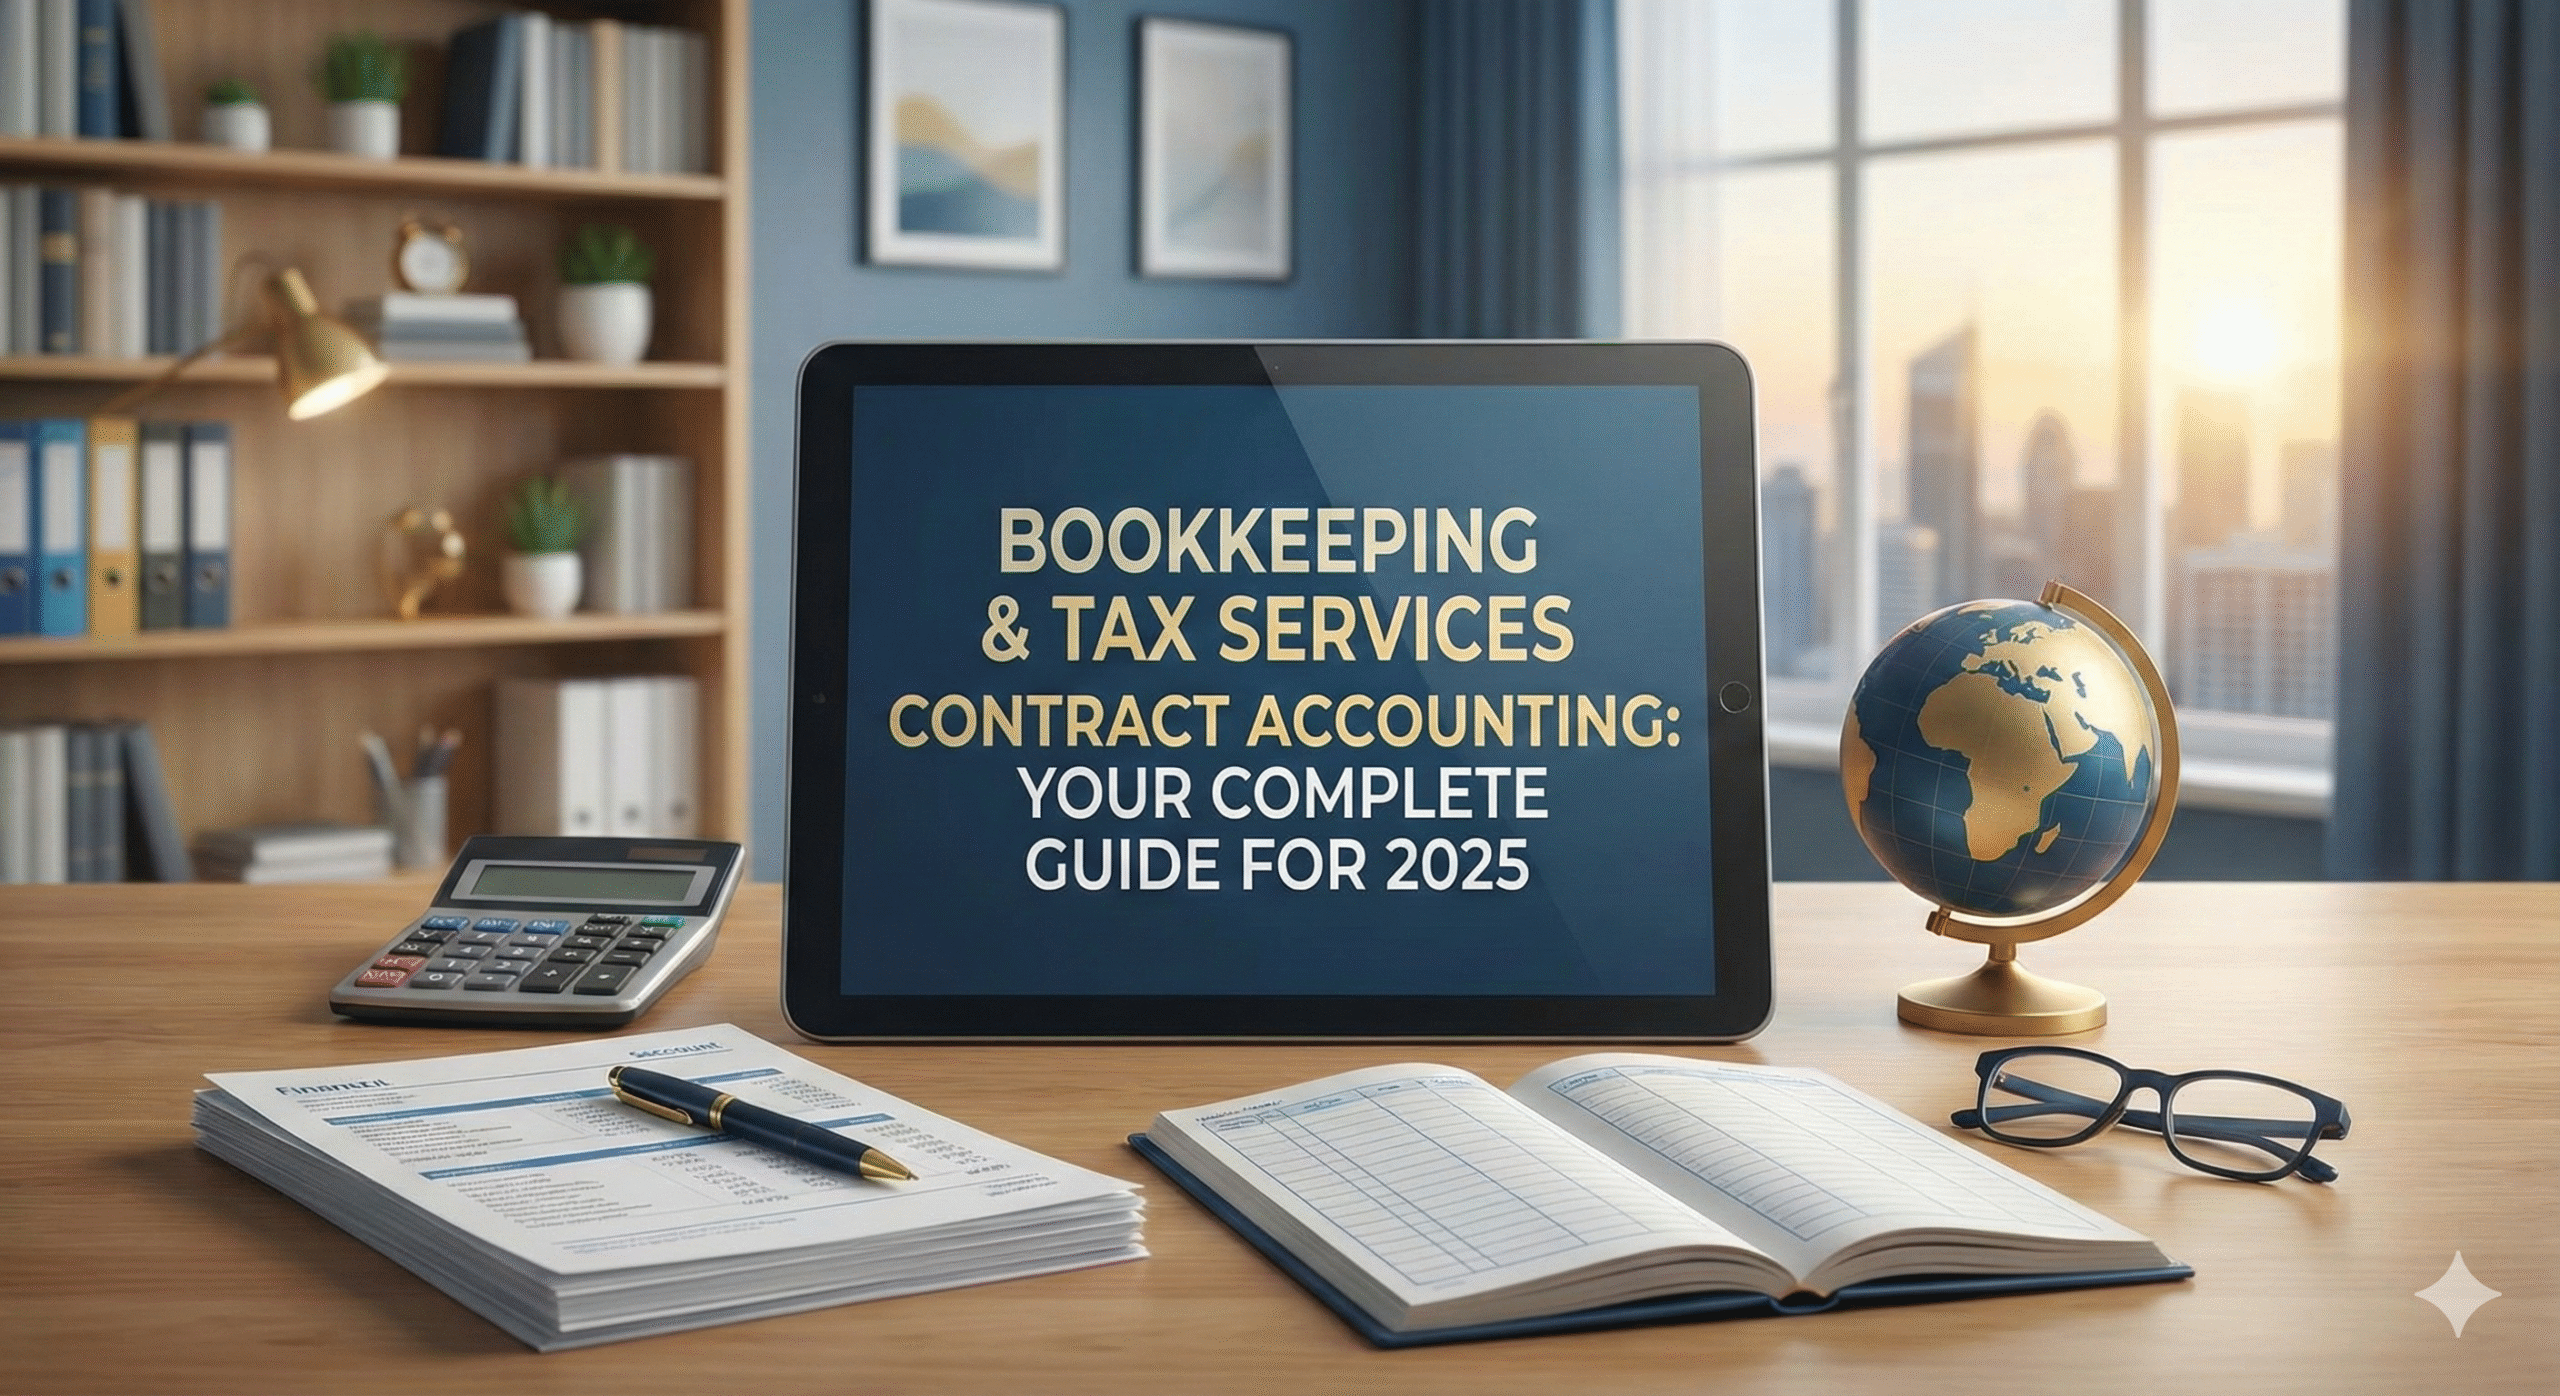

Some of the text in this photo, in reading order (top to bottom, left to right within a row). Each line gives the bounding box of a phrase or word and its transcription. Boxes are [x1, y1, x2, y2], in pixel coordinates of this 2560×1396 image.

[999, 506, 1538, 574] BOOKKEEPING
[982, 594, 1574, 662] & TAX SERVICES
[889, 694, 1681, 748] CONTRACT ACCOUNTING:
[1017, 766, 1549, 820] YOUR COMPLETE
[1026, 837, 1529, 891] GUIDE FOR 2025
